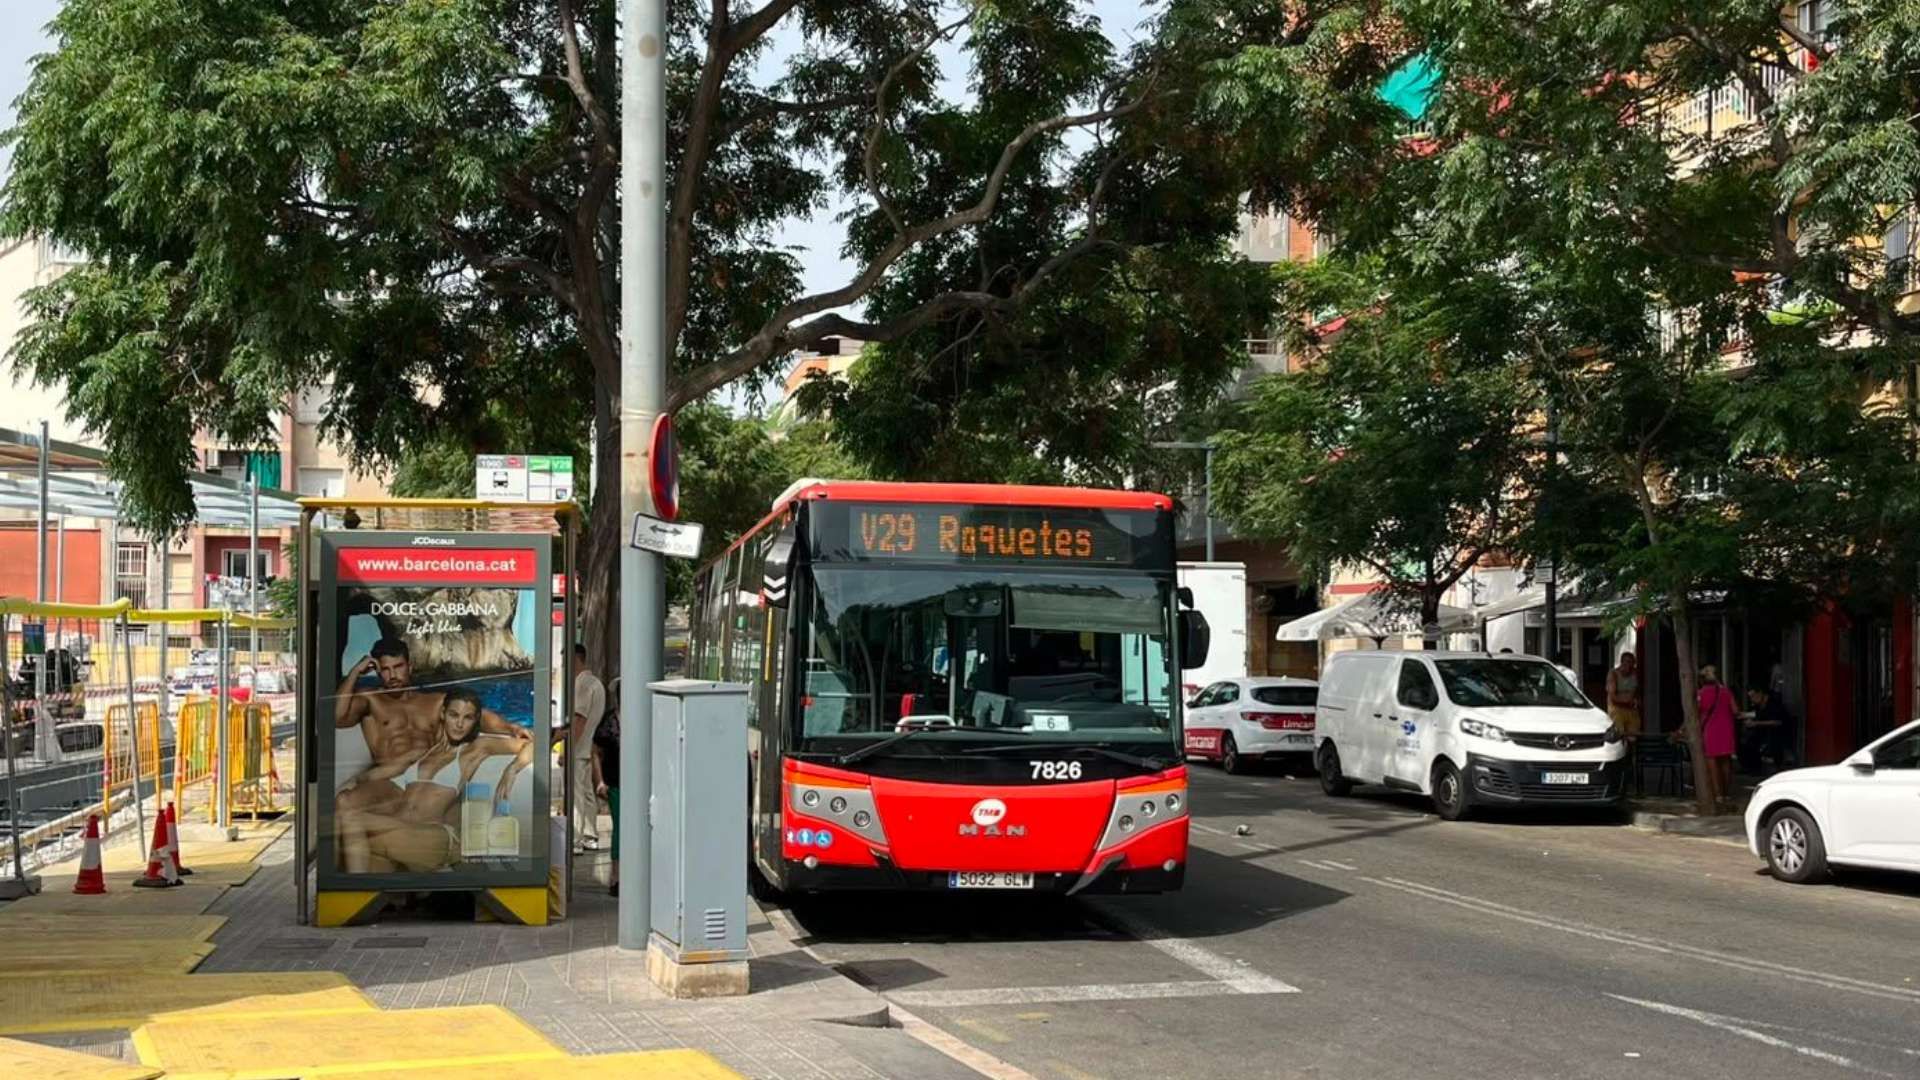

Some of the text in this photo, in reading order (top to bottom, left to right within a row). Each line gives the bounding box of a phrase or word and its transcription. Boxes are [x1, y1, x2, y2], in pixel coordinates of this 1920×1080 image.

[860, 512, 917, 551] V29
[357, 557, 516, 572] www.barcelona.cat
[371, 602, 416, 616] DOLCE
[425, 602, 498, 616] GABBANA
[1047, 717, 1055, 729] 6
[1030, 761, 1082, 779] 7826
[959, 824, 1026, 836] MAN
[959, 873, 1030, 887] 5032 GLW
